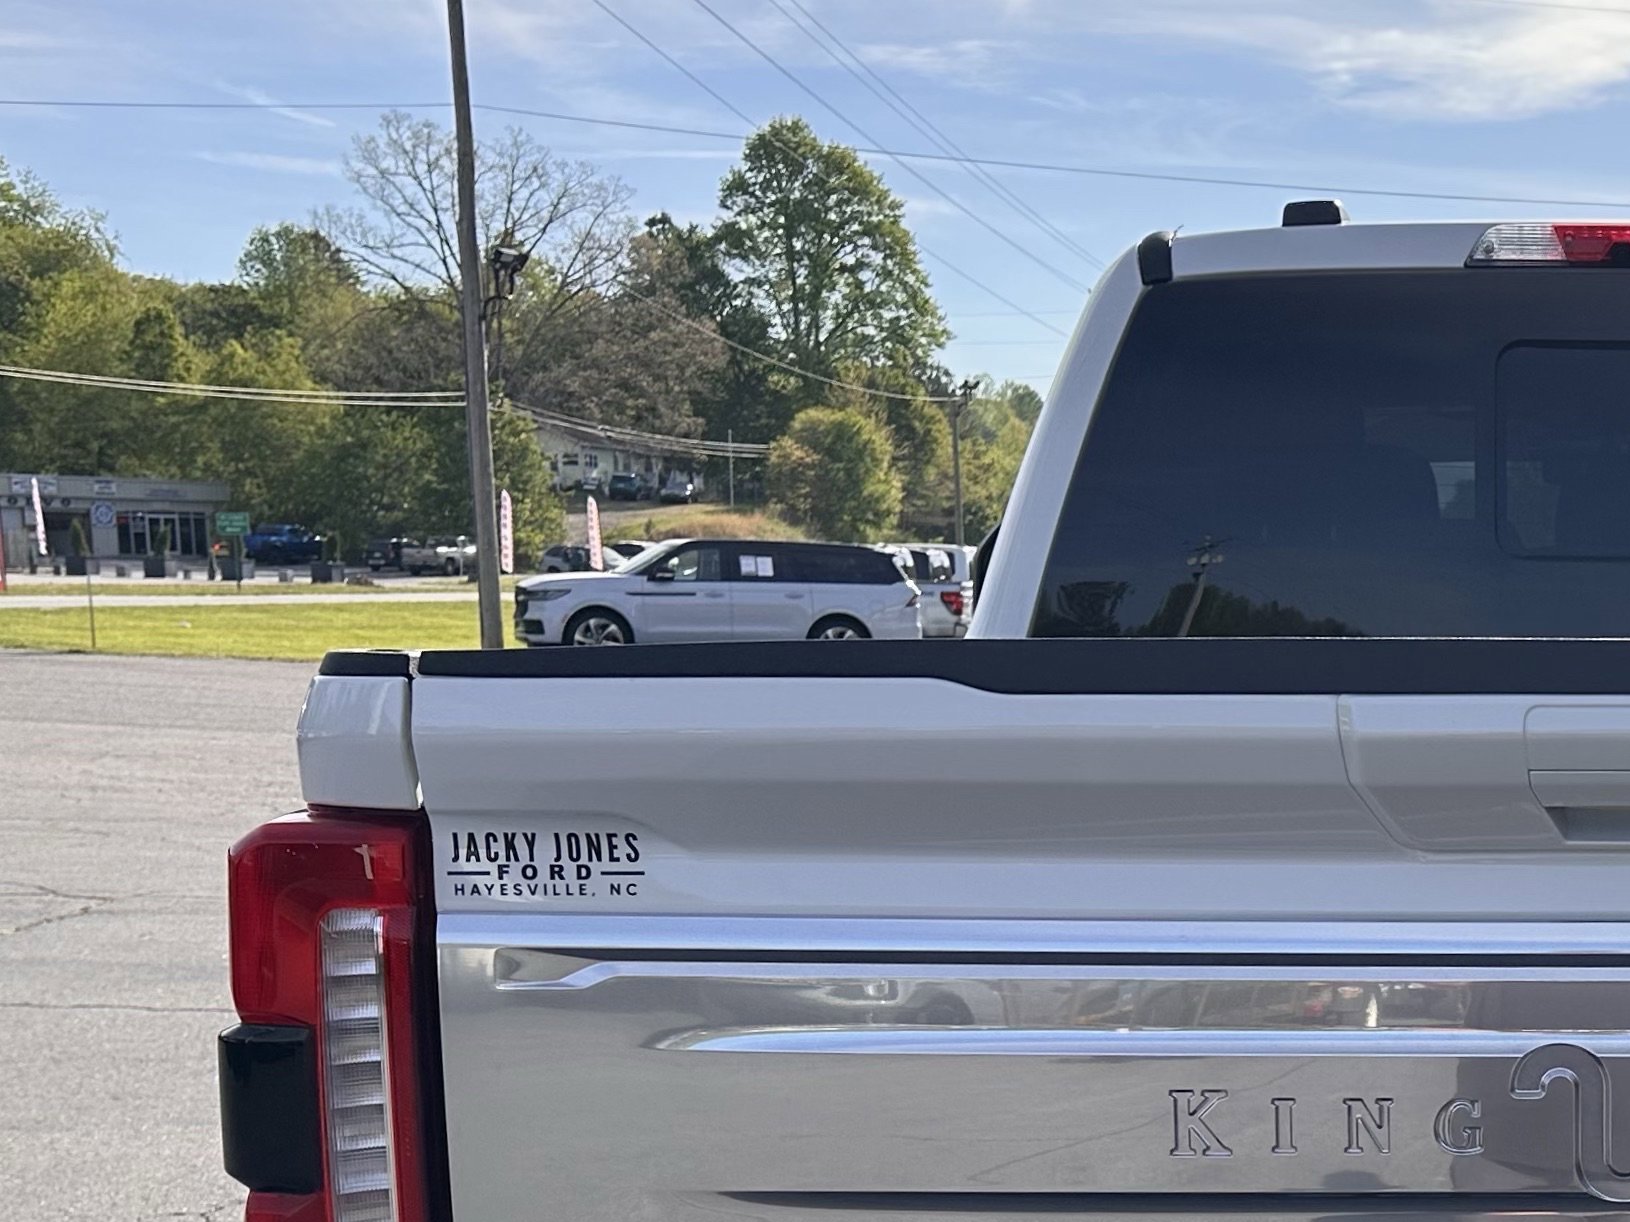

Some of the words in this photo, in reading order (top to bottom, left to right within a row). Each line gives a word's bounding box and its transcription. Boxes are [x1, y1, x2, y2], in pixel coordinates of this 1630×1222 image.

[451, 832, 536, 863] JACKY
[553, 832, 641, 863] JONES
[497, 864, 592, 881] FORD
[454, 884, 596, 897] HAYESVILLE,
[609, 884, 639, 896] NC
[1168, 1089, 1485, 1157] KING
